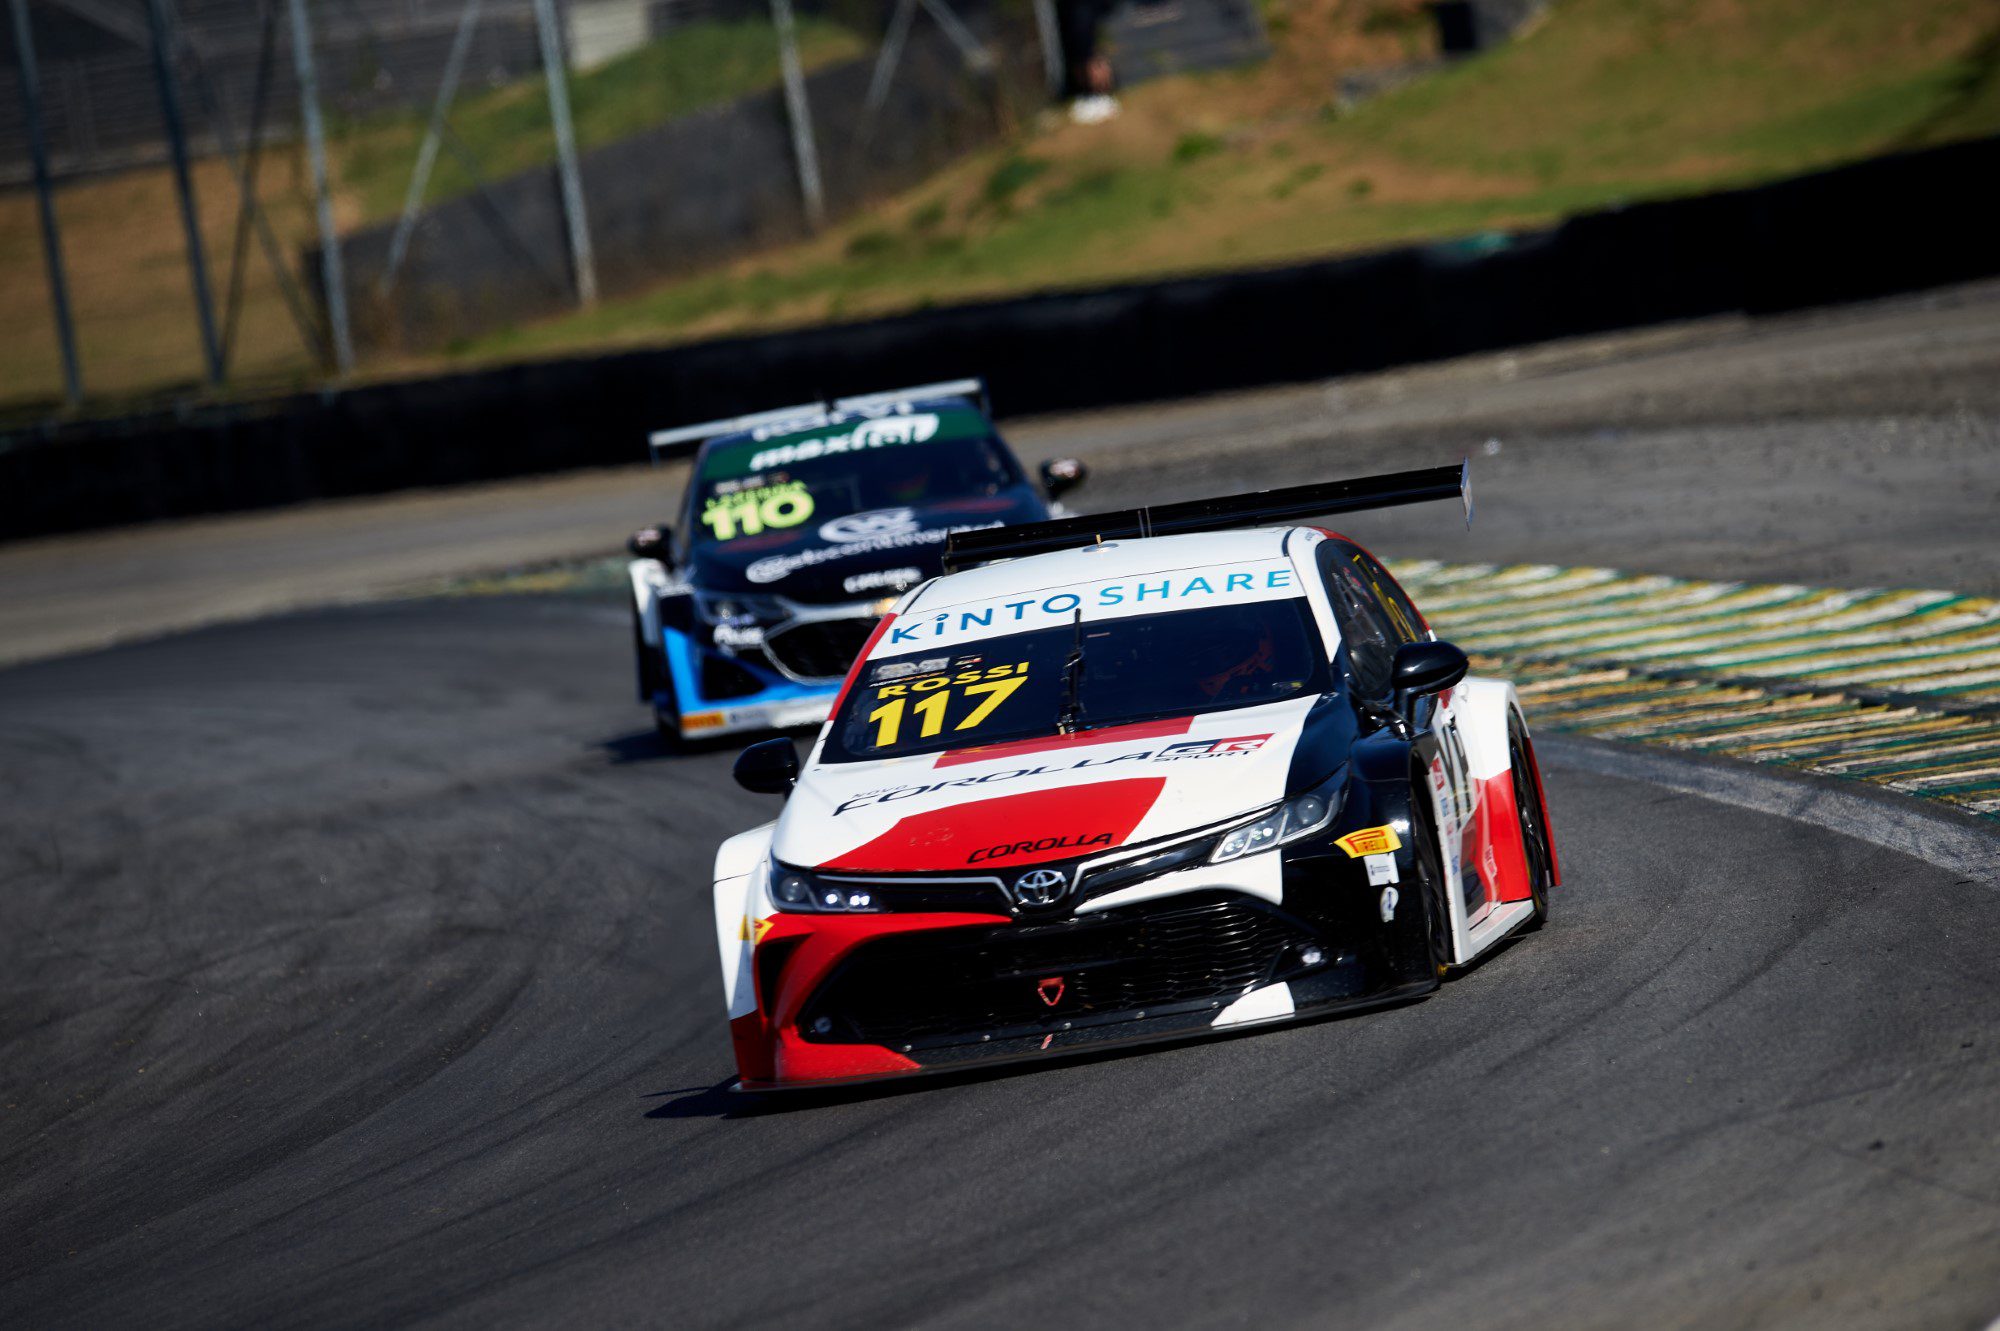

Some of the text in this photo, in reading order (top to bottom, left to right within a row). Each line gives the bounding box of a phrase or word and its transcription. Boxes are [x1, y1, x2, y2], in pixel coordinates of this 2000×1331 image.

[702, 489, 814, 541] 110
[1099, 569, 1292, 606] SHARE
[877, 661, 1030, 700] ROSSI
[868, 675, 1029, 747] 117
[1152, 749, 1252, 763] SPORT
[832, 750, 1155, 817] COROLLA
[966, 832, 1114, 865] COROLLA
